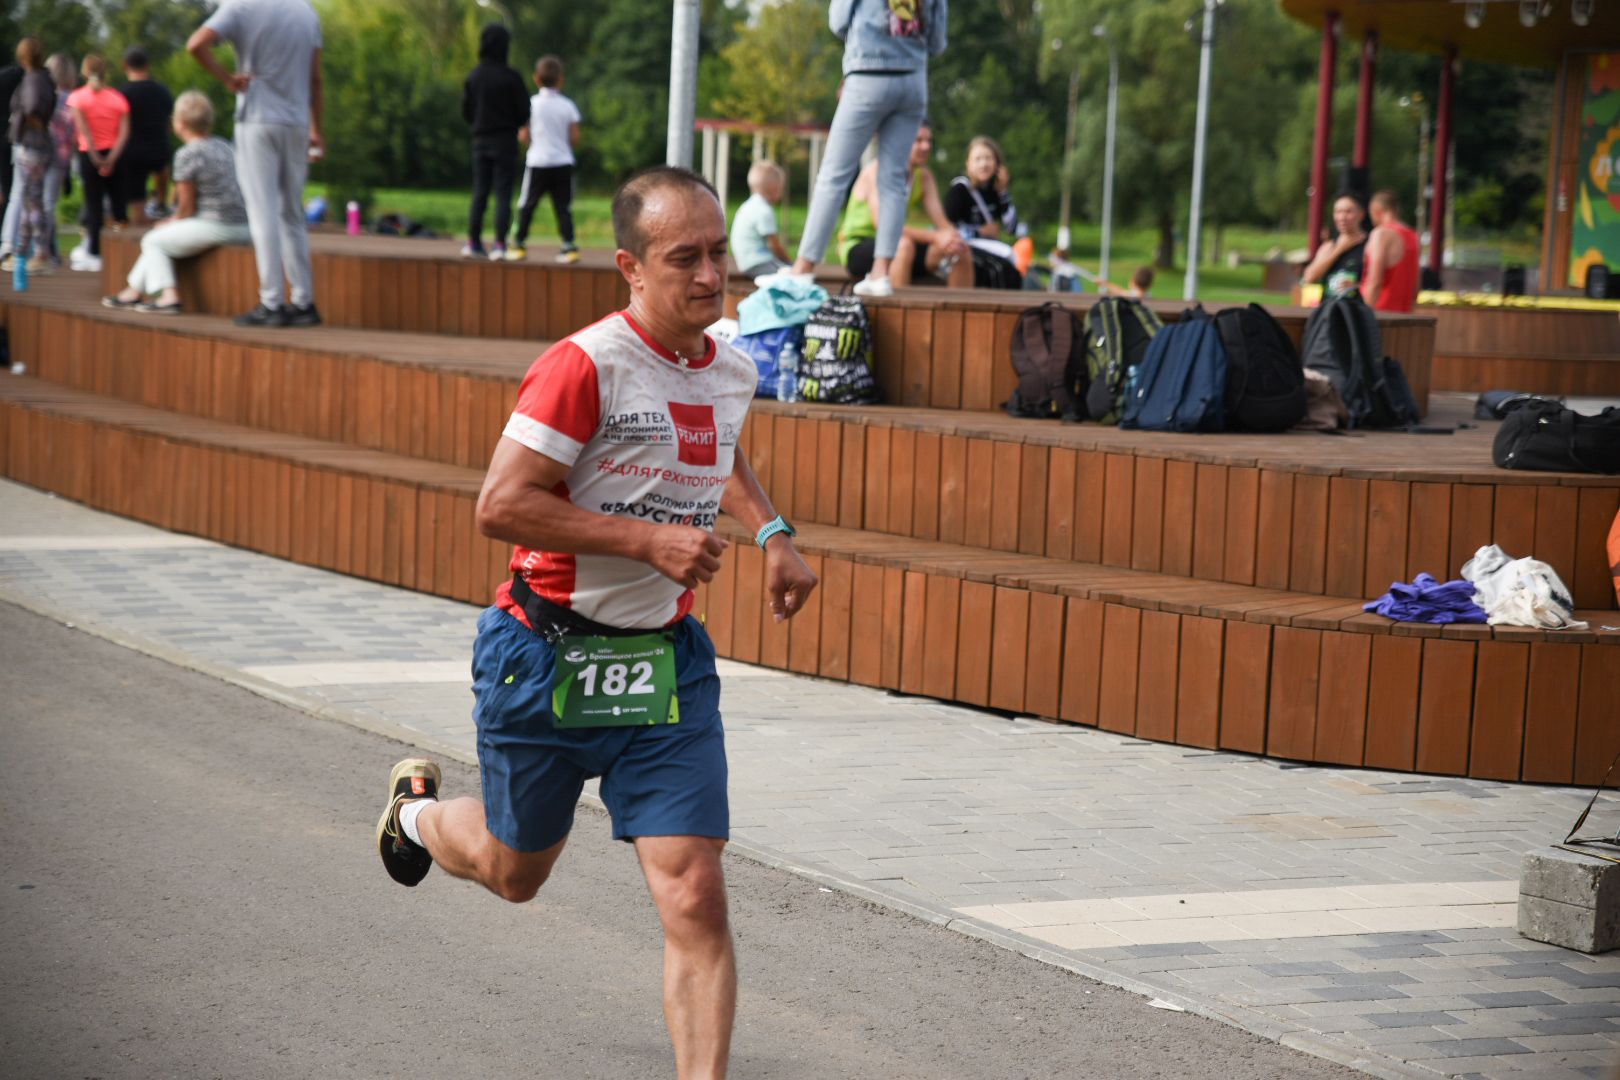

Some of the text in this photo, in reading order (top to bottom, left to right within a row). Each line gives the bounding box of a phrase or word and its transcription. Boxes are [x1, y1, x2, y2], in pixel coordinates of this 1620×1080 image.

[605, 412, 639, 428] ДЛЯ
[623, 434, 658, 442] ПРОСТО
[677, 427, 715, 446] РЕМИТ
[597, 458, 724, 488] #длятехктопон
[577, 661, 656, 697] 182
